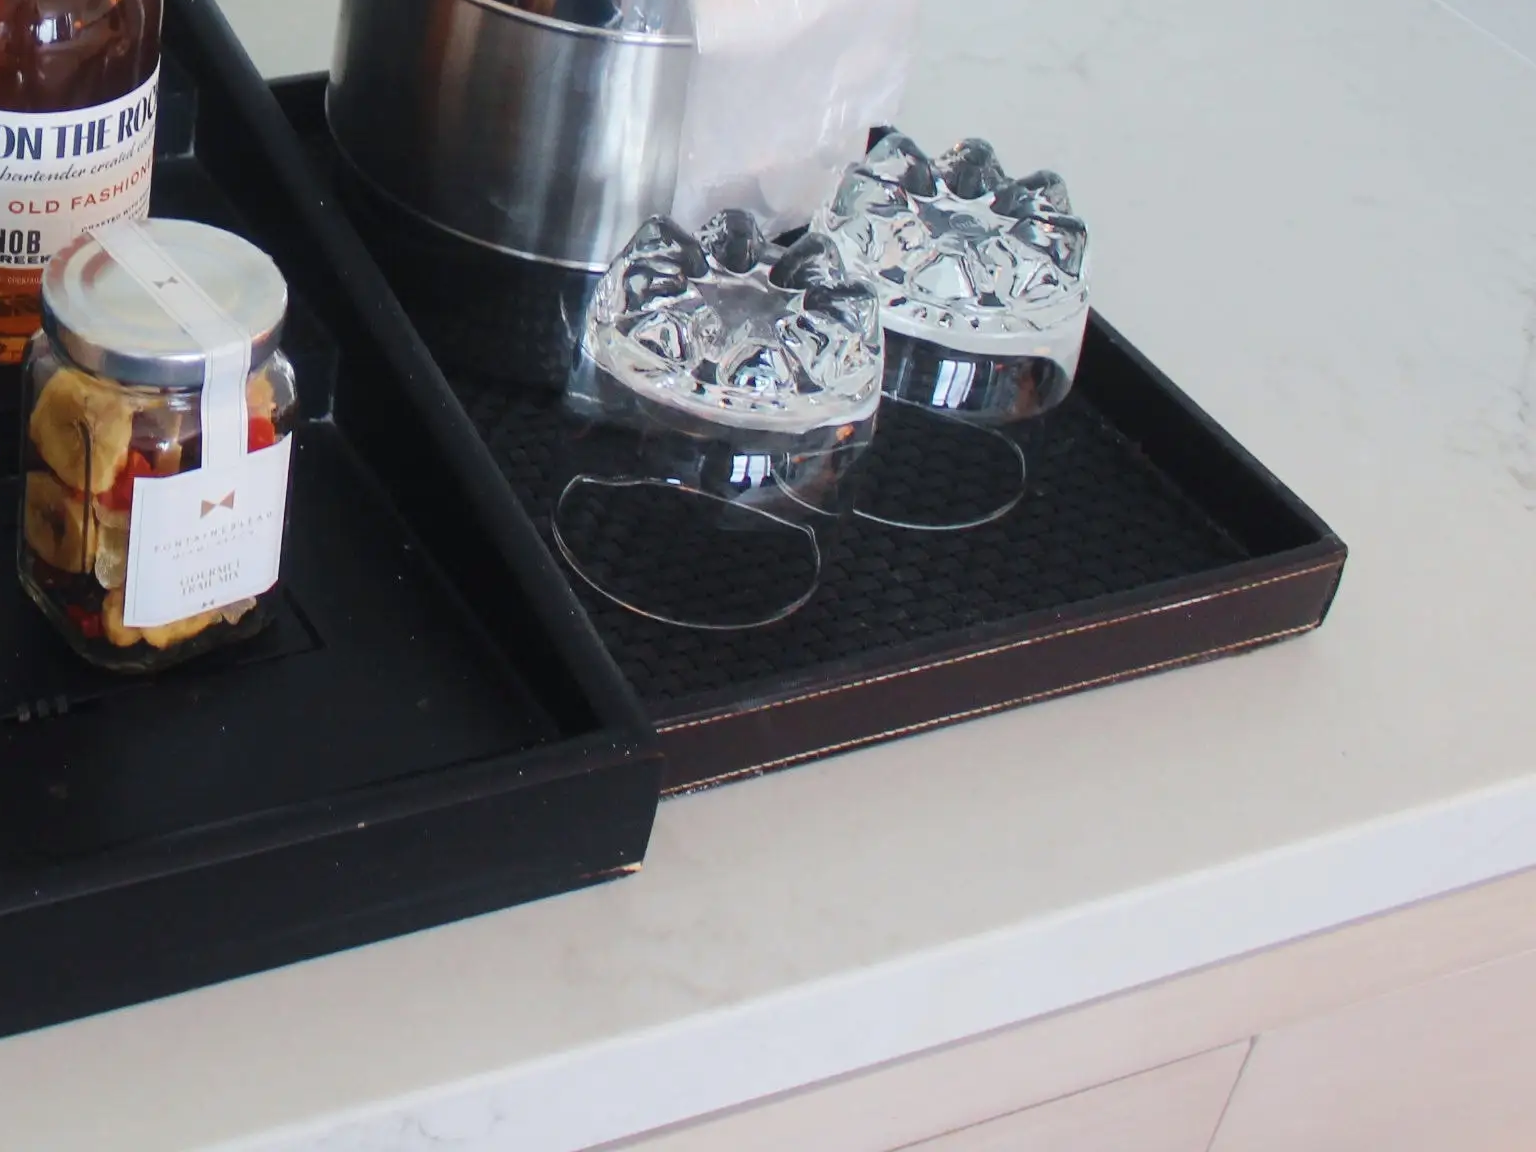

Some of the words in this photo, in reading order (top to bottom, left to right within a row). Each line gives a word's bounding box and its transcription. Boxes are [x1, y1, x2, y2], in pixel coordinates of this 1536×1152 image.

[49, 114, 114, 159] THE
[117, 81, 158, 144] ROC
[90, 141, 135, 175] created
[8, 200, 61, 215] OLD
[154, 510, 272, 553] FONTAINEBLEAU
